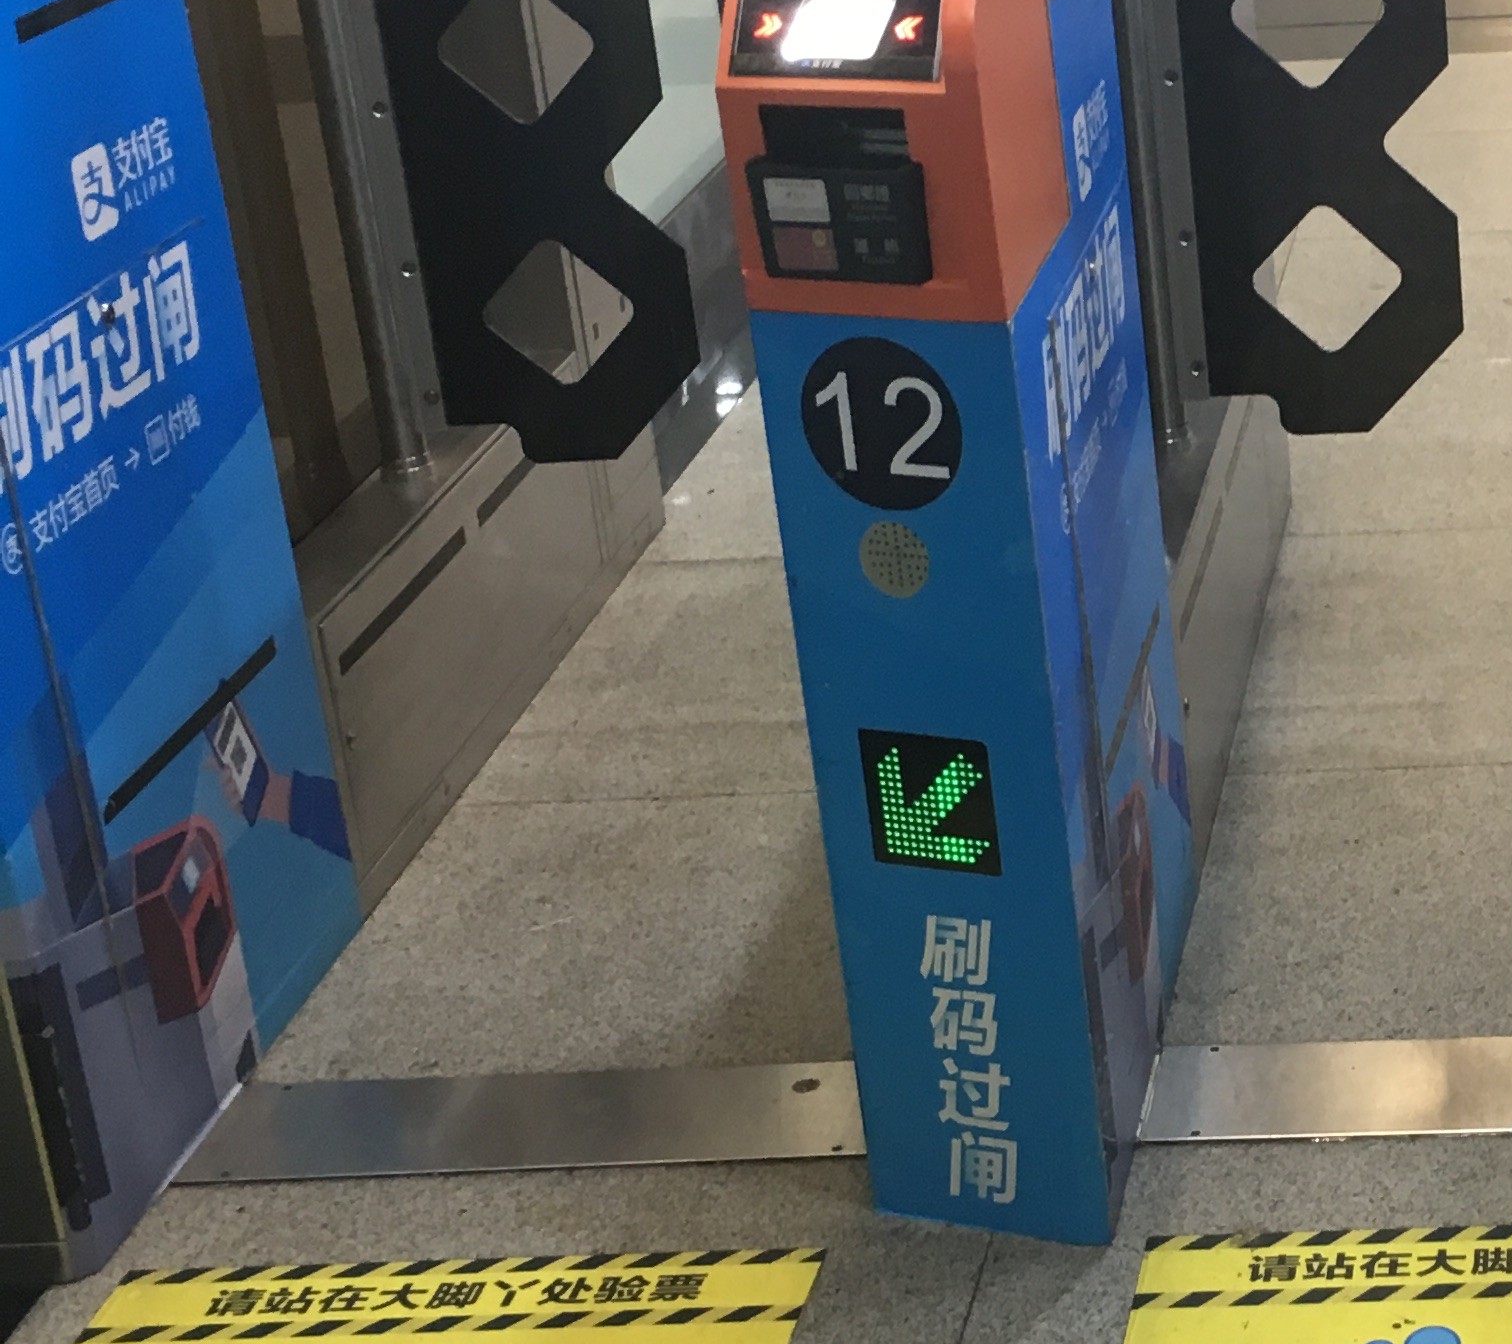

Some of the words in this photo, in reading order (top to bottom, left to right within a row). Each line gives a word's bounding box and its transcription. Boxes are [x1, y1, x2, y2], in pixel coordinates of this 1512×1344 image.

[112, 116, 174, 190] 支付宝
[122, 165, 177, 213] ALIPAY
[815, 369, 951, 480] 12
[29, 455, 120, 554] 支付宝首页
[919, 914, 1019, 1205] 刷码过闸
[205, 1272, 710, 1319] 请站在大脚丫处验票
